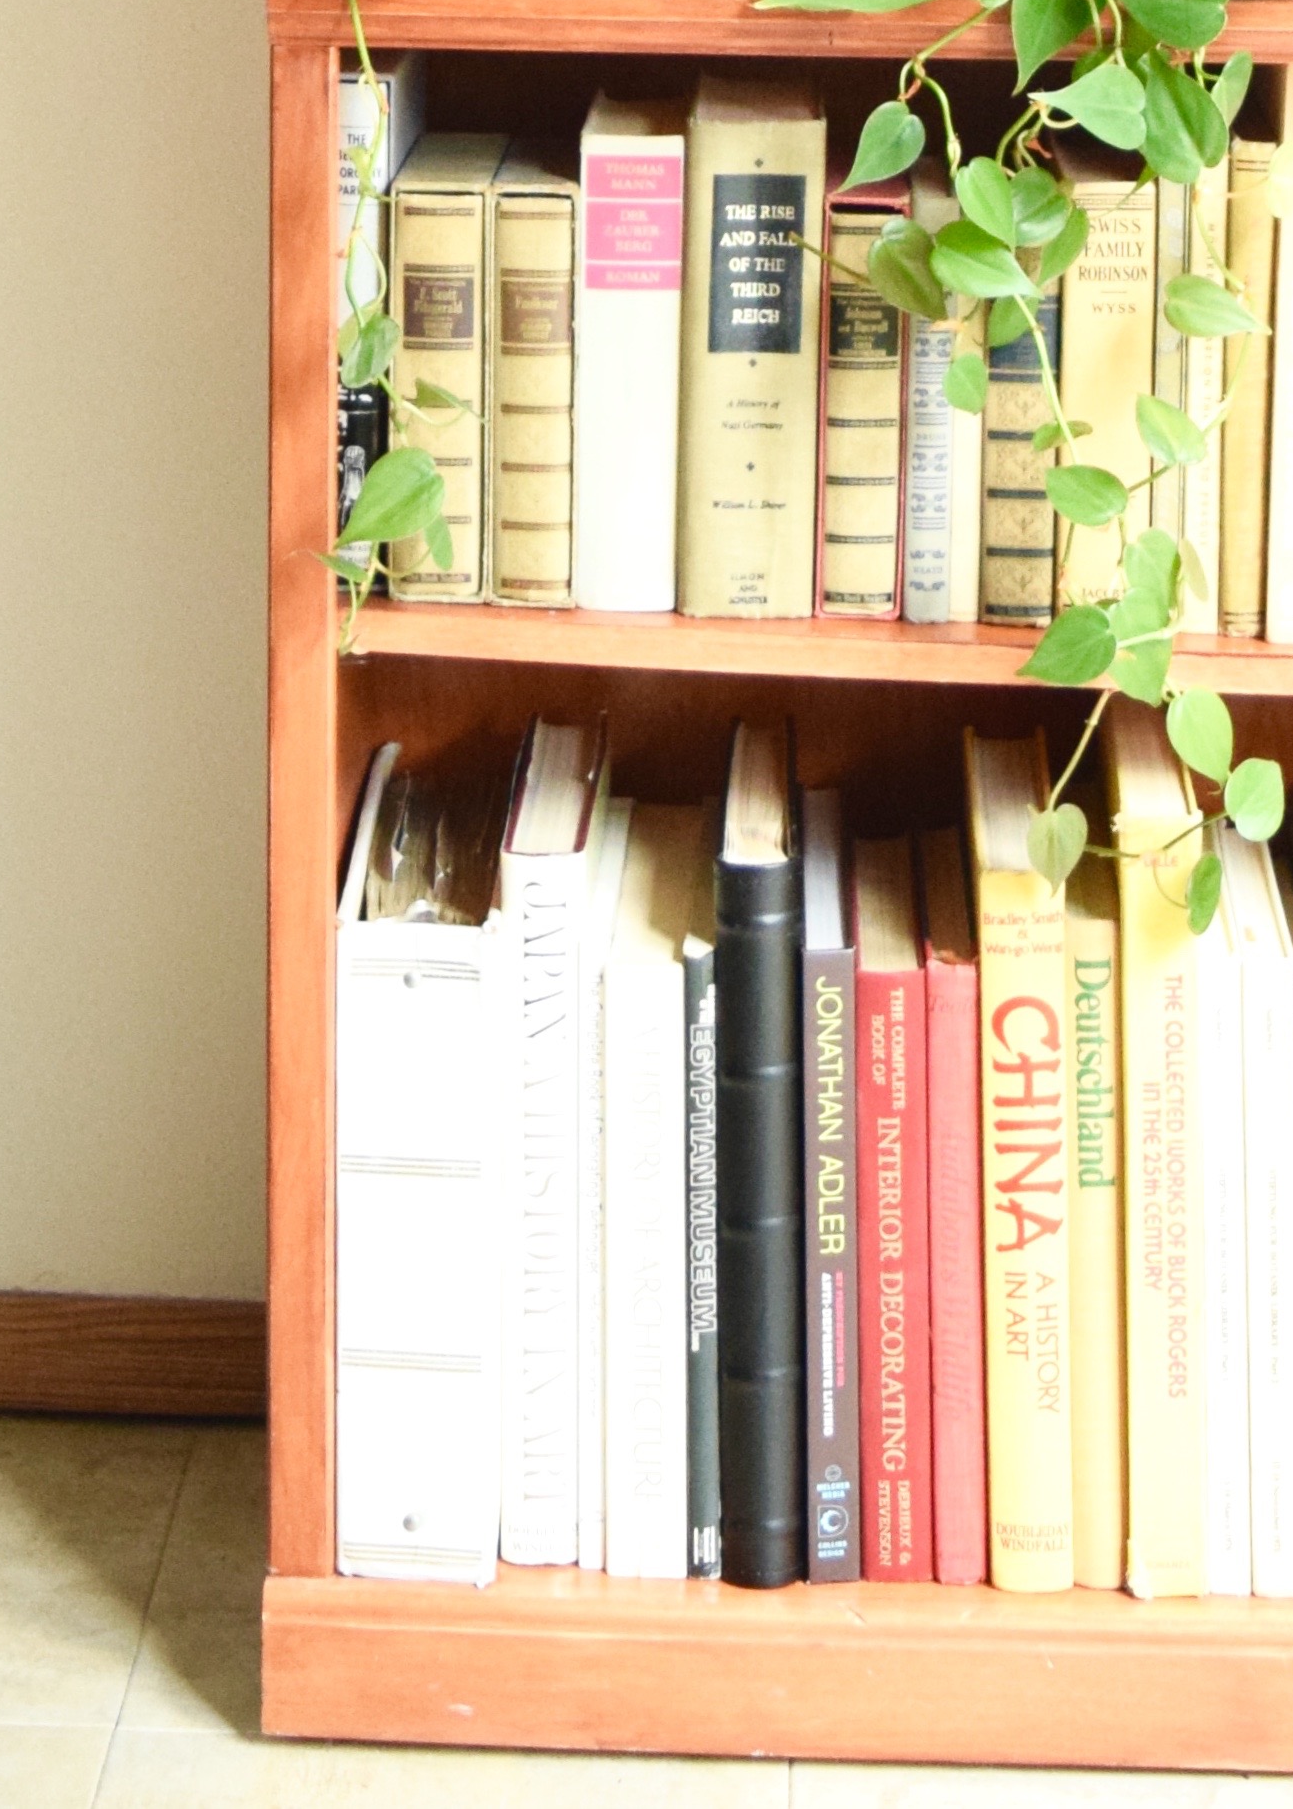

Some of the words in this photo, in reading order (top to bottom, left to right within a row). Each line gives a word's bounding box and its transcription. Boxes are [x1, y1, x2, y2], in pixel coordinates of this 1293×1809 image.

[347, 133, 367, 146] THE
[604, 162, 665, 177] THOMAS
[611, 178, 657, 190] MANN
[620, 209, 649, 222] DER
[725, 203, 757, 221] THE
[760, 204, 796, 221] RISE
[1088, 217, 1142, 234] SWISS
[615, 240, 653, 253] BERG
[719, 230, 755, 247] AND
[758, 231, 798, 247] FALL
[1083, 242, 1144, 259] FAMILY
[606, 271, 661, 285] ROMAN
[729, 256, 751, 273] OF
[754, 256, 786, 273] THE
[1077, 266, 1149, 282] ROBINSON
[730, 283, 781, 299] THIRD
[1091, 303, 1138, 314] WYSS
[732, 308, 781, 325] REICH
[889, 987, 905, 1022] THE
[1164, 974, 1185, 1013] THE
[872, 1014, 887, 1060] BOOK
[816, 976, 844, 1143] JONATHAN
[872, 1062, 887, 1086] OF
[891, 1025, 907, 1111] COMPLETE
[1073, 956, 1117, 1190] Deutschland
[1165, 1020, 1185, 1133] COLLECTED
[689, 1023, 717, 1187] EGYPTIAN
[991, 996, 1064, 1253] CHINA
[1142, 1108, 1162, 1146] THE
[876, 1116, 905, 1262] INTERIOR
[1143, 1152, 1163, 1198] 25th
[1166, 1138, 1187, 1217] WORKS
[817, 1155, 846, 1256] ADLER
[1167, 1222, 1187, 1249] OF
[689, 1188, 718, 1334] MUSEUM
[1004, 1271, 1028, 1300] IN
[1035, 1271, 1056, 1294] A
[1167, 1255, 1187, 1310] BUCK
[1005, 1307, 1030, 1363] ART
[880, 1270, 907, 1472] DECORATING
[1036, 1303, 1061, 1414] HISTORY
[1167, 1314, 1188, 1399] ROGERS
[878, 1479, 893, 1566] STEVENSON
[897, 1480, 912, 1549] DERIEUX
